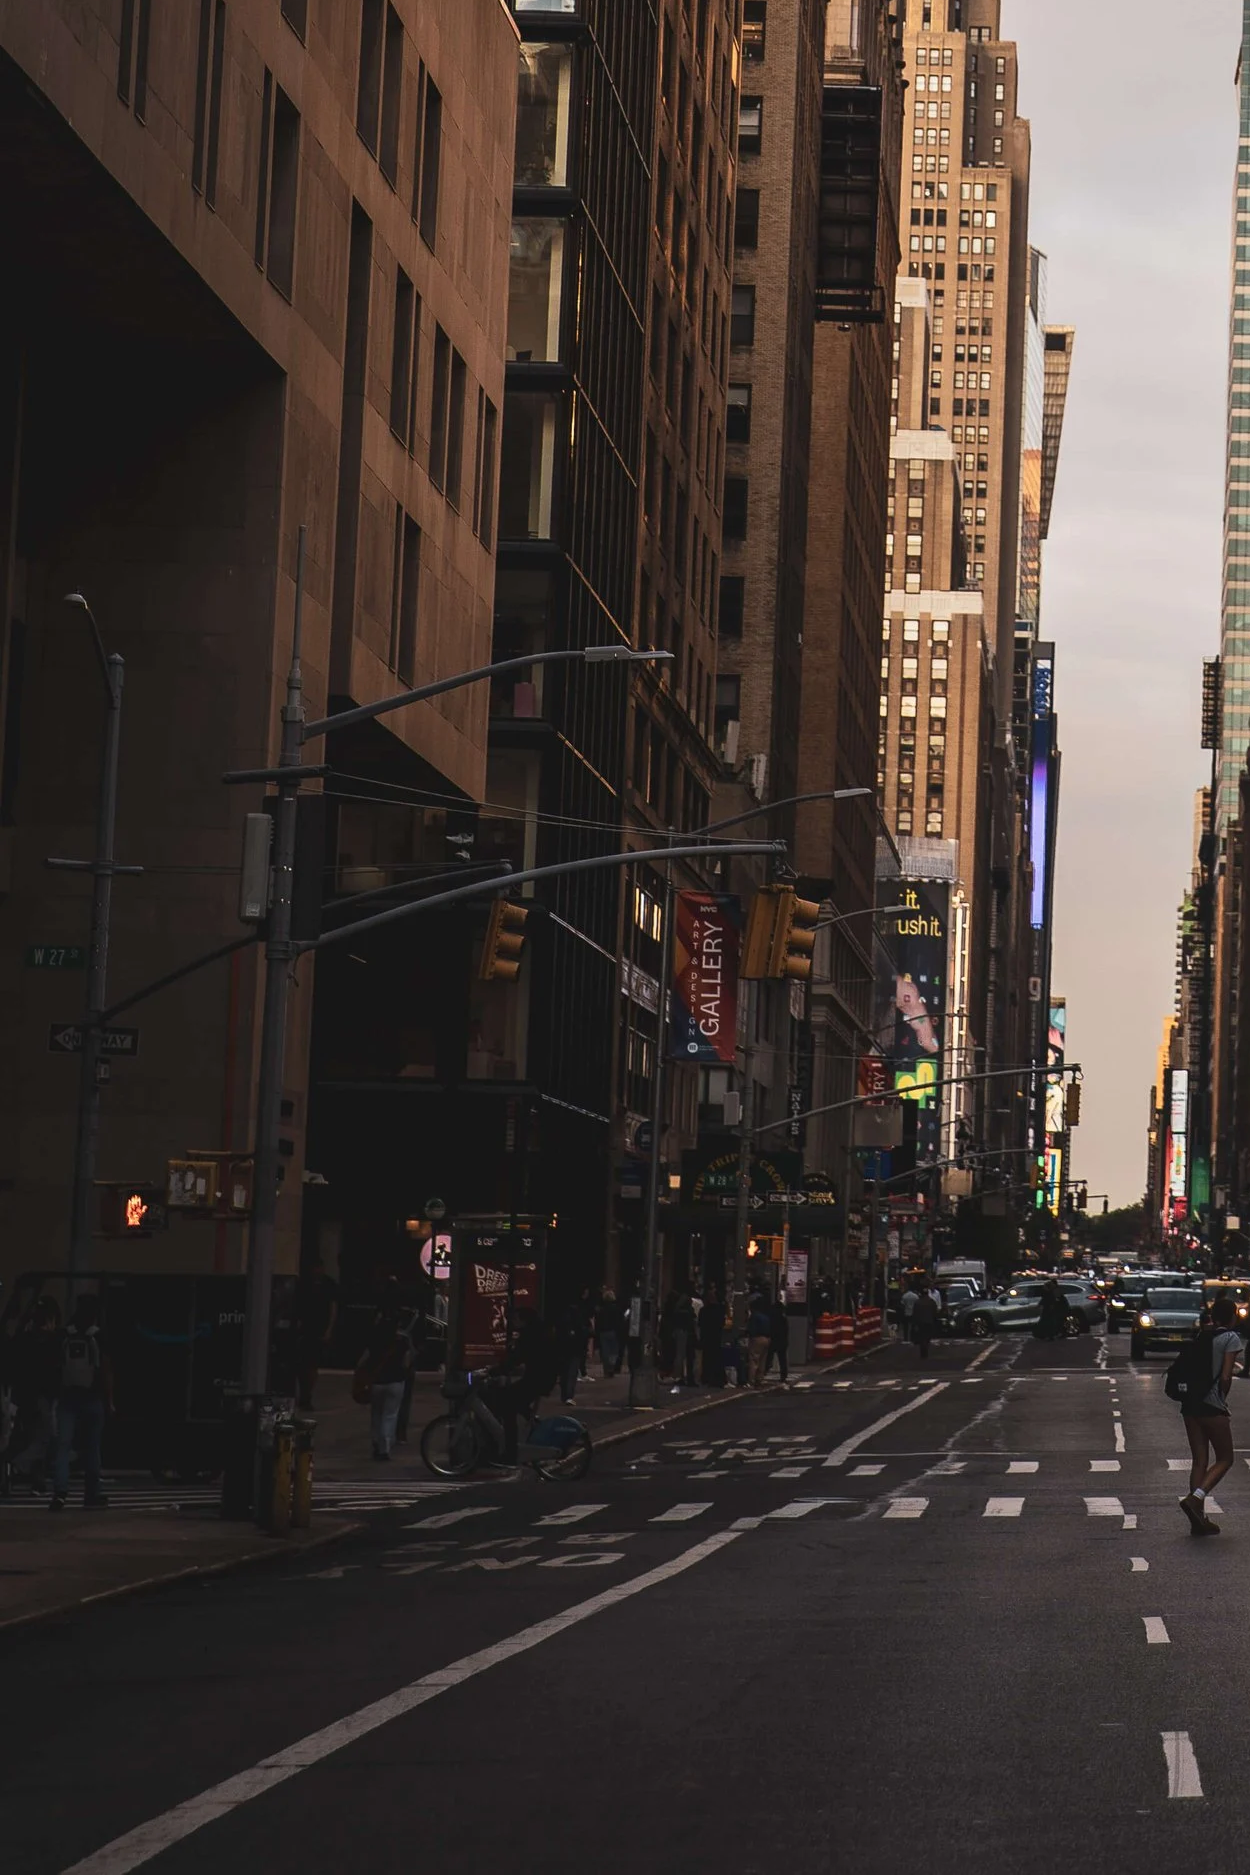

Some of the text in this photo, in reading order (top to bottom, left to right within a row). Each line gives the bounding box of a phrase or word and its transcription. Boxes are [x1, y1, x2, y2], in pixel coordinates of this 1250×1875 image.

[700, 905, 718, 913] NYC
[692, 920, 700, 950] ART
[34, 948, 45, 965] W
[49, 948, 65, 966] 27
[699, 920, 723, 1036] GALLERY
[688, 972, 698, 1036] DESIGN
[63, 1031, 83, 1045] ON
[791, 1092, 801, 1135] NAILS
[759, 1159, 787, 1192] CROW
